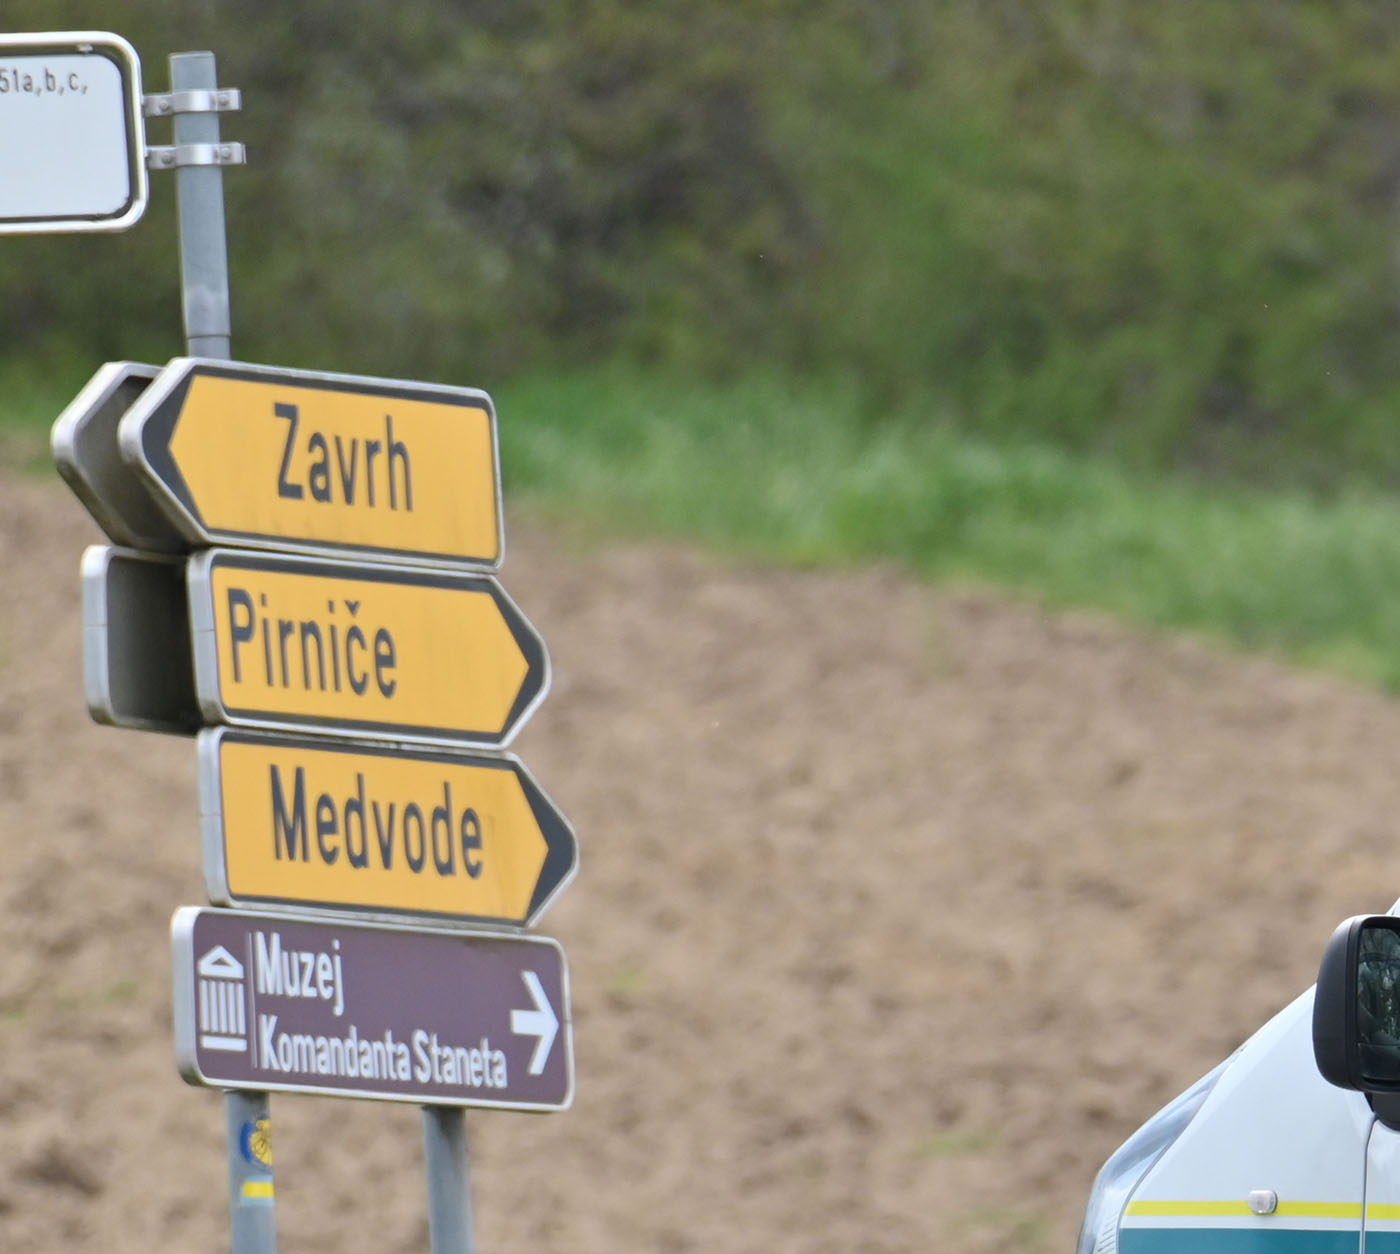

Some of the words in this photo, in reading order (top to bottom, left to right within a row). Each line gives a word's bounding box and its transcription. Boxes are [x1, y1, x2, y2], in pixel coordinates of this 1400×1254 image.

[273, 402, 414, 512] Zavrh
[226, 587, 398, 699] Pirniče
[269, 764, 484, 880] Medvode
[254, 931, 344, 1016] Muzej
[259, 1015, 411, 1081] Komandanta
[413, 1029, 508, 1089] Staneta
